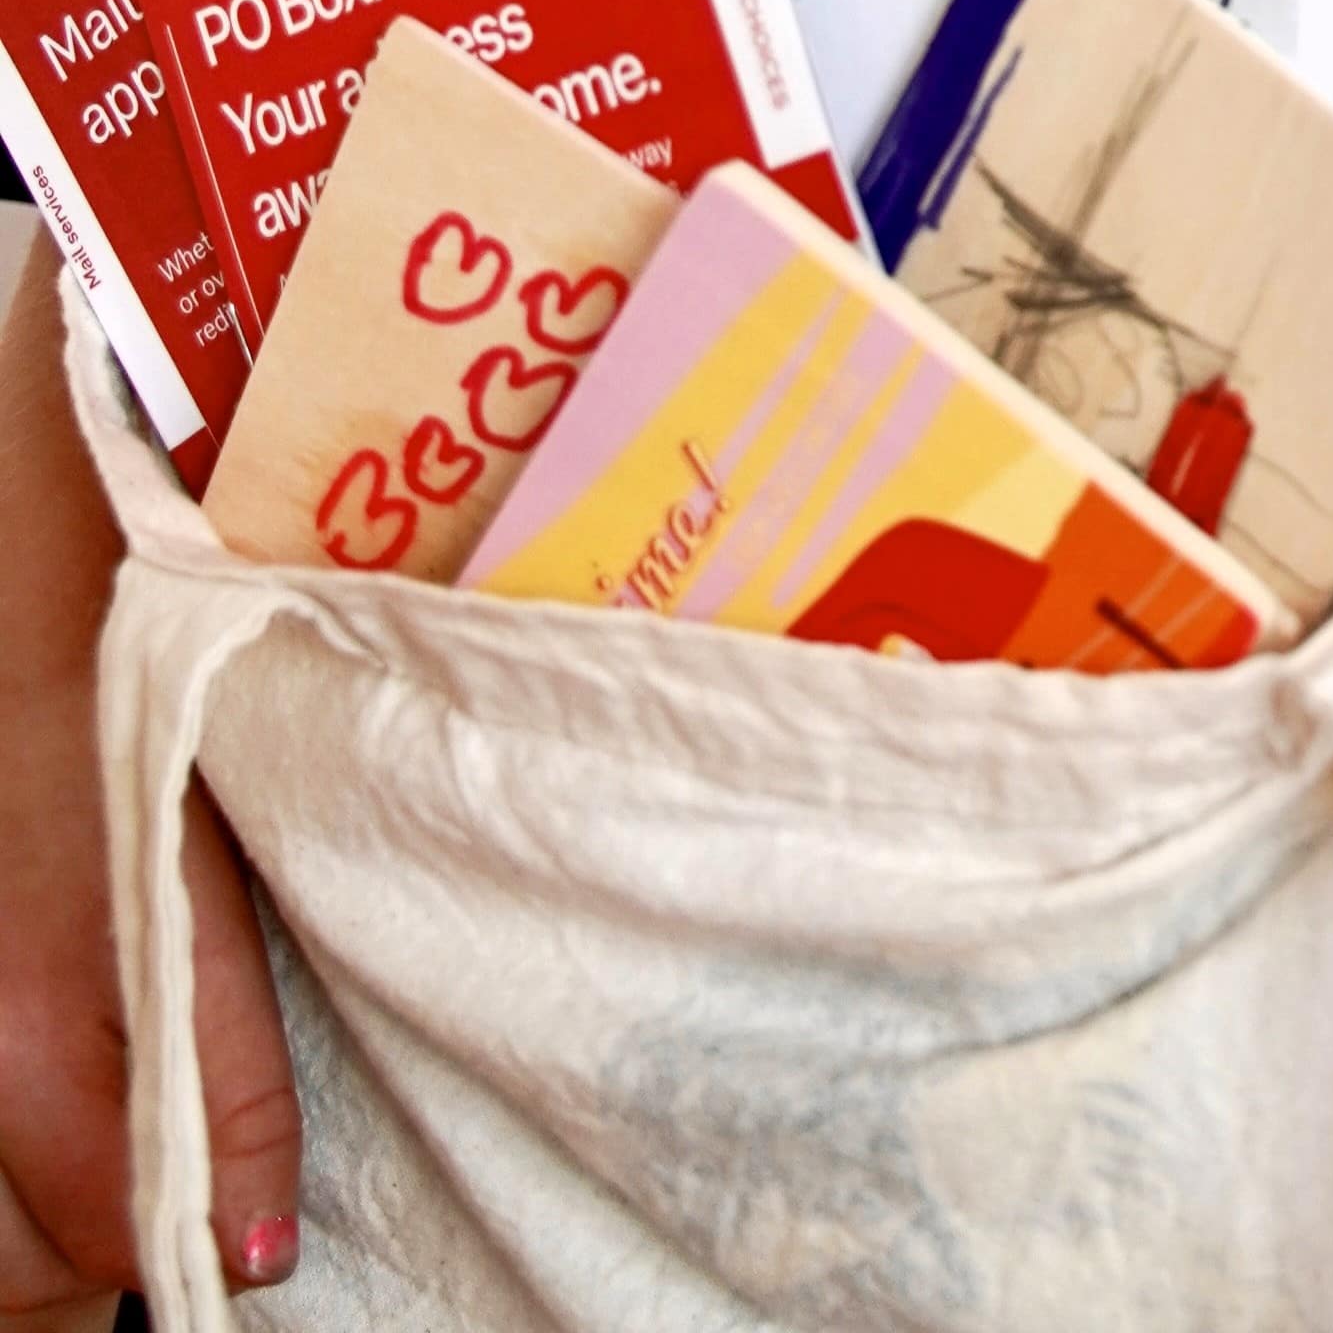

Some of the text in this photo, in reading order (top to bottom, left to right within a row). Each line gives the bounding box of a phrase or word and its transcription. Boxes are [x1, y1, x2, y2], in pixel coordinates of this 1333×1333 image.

[82, 60, 166, 145] app
[219, 80, 327, 155] Your
[533, 52, 662, 123] ome.
[32, 164, 102, 291] Mail services
[157, 231, 215, 284] Whet
[178, 290, 201, 315] or
